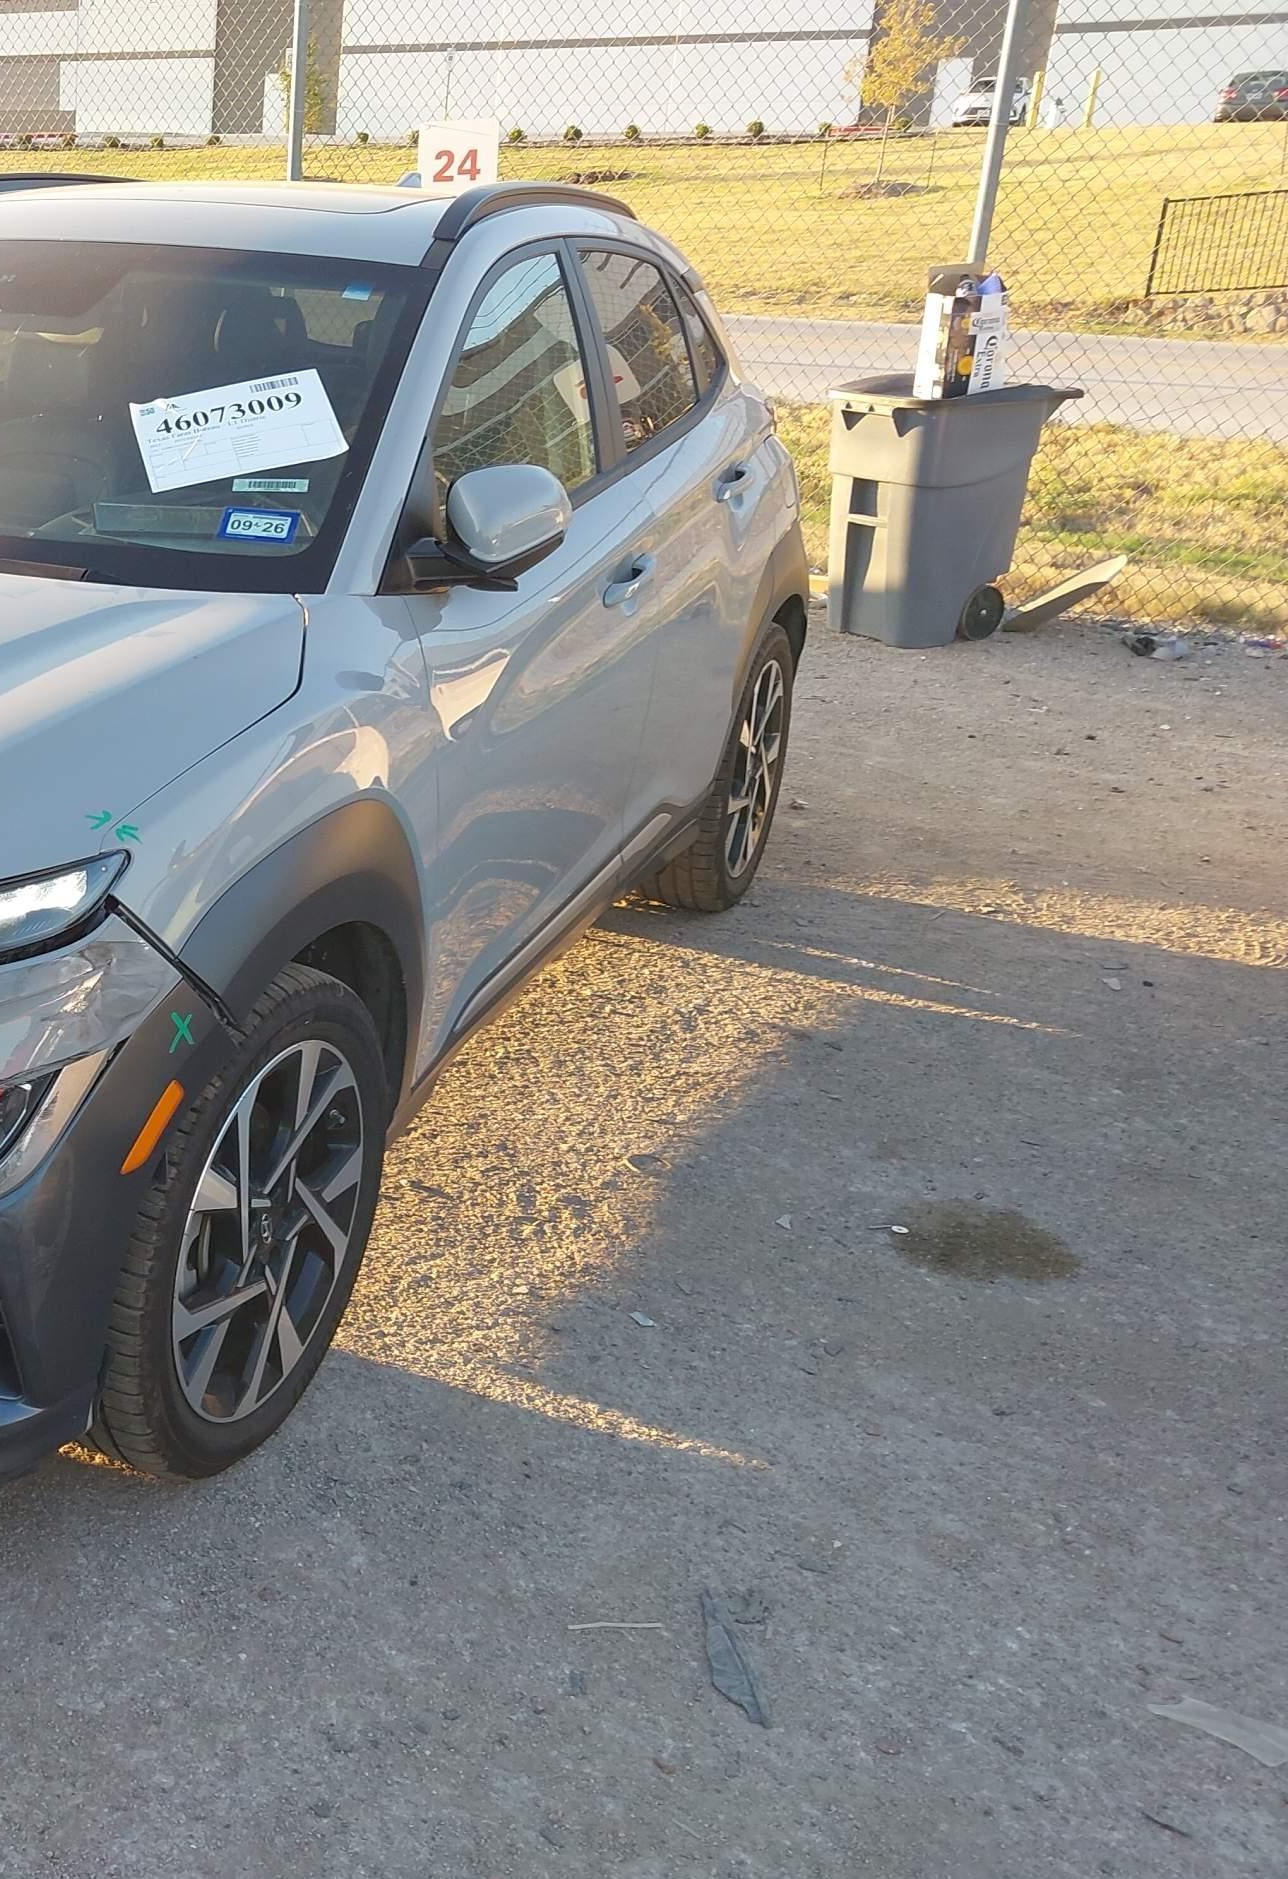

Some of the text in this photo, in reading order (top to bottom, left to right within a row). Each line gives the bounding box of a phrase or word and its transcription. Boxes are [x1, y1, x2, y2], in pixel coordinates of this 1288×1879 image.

[433, 149, 481, 182] 24
[973, 351, 986, 377] Extra
[979, 335, 1000, 389] Corona
[155, 392, 303, 434] 46073009
[230, 519, 286, 534] 09 26
